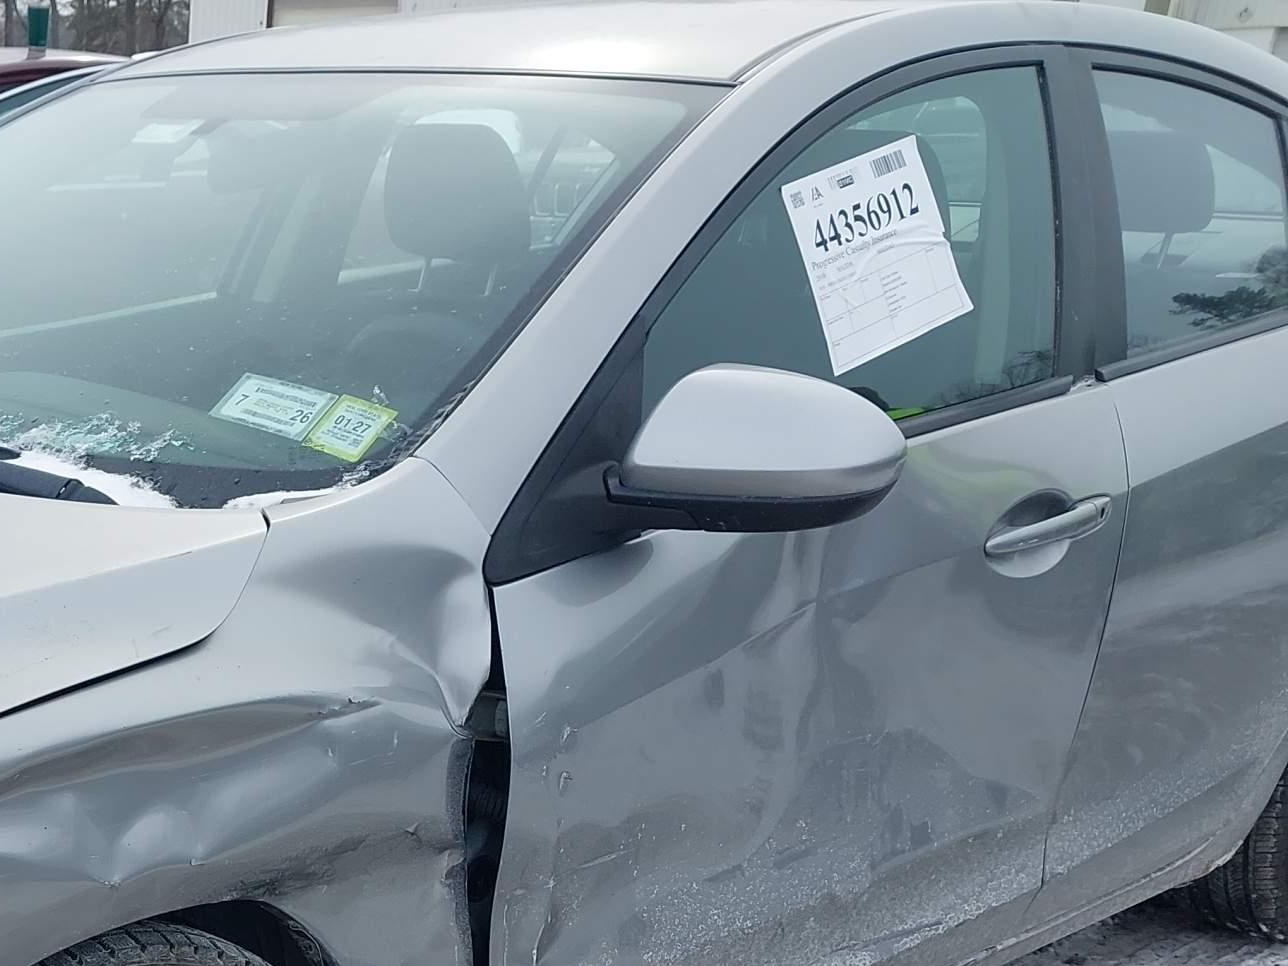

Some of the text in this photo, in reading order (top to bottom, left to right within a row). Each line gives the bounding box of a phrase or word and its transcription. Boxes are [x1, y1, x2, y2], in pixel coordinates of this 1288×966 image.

[814, 182, 920, 252] 44356912
[234, 393, 251, 406] 7
[289, 409, 313, 424] 26
